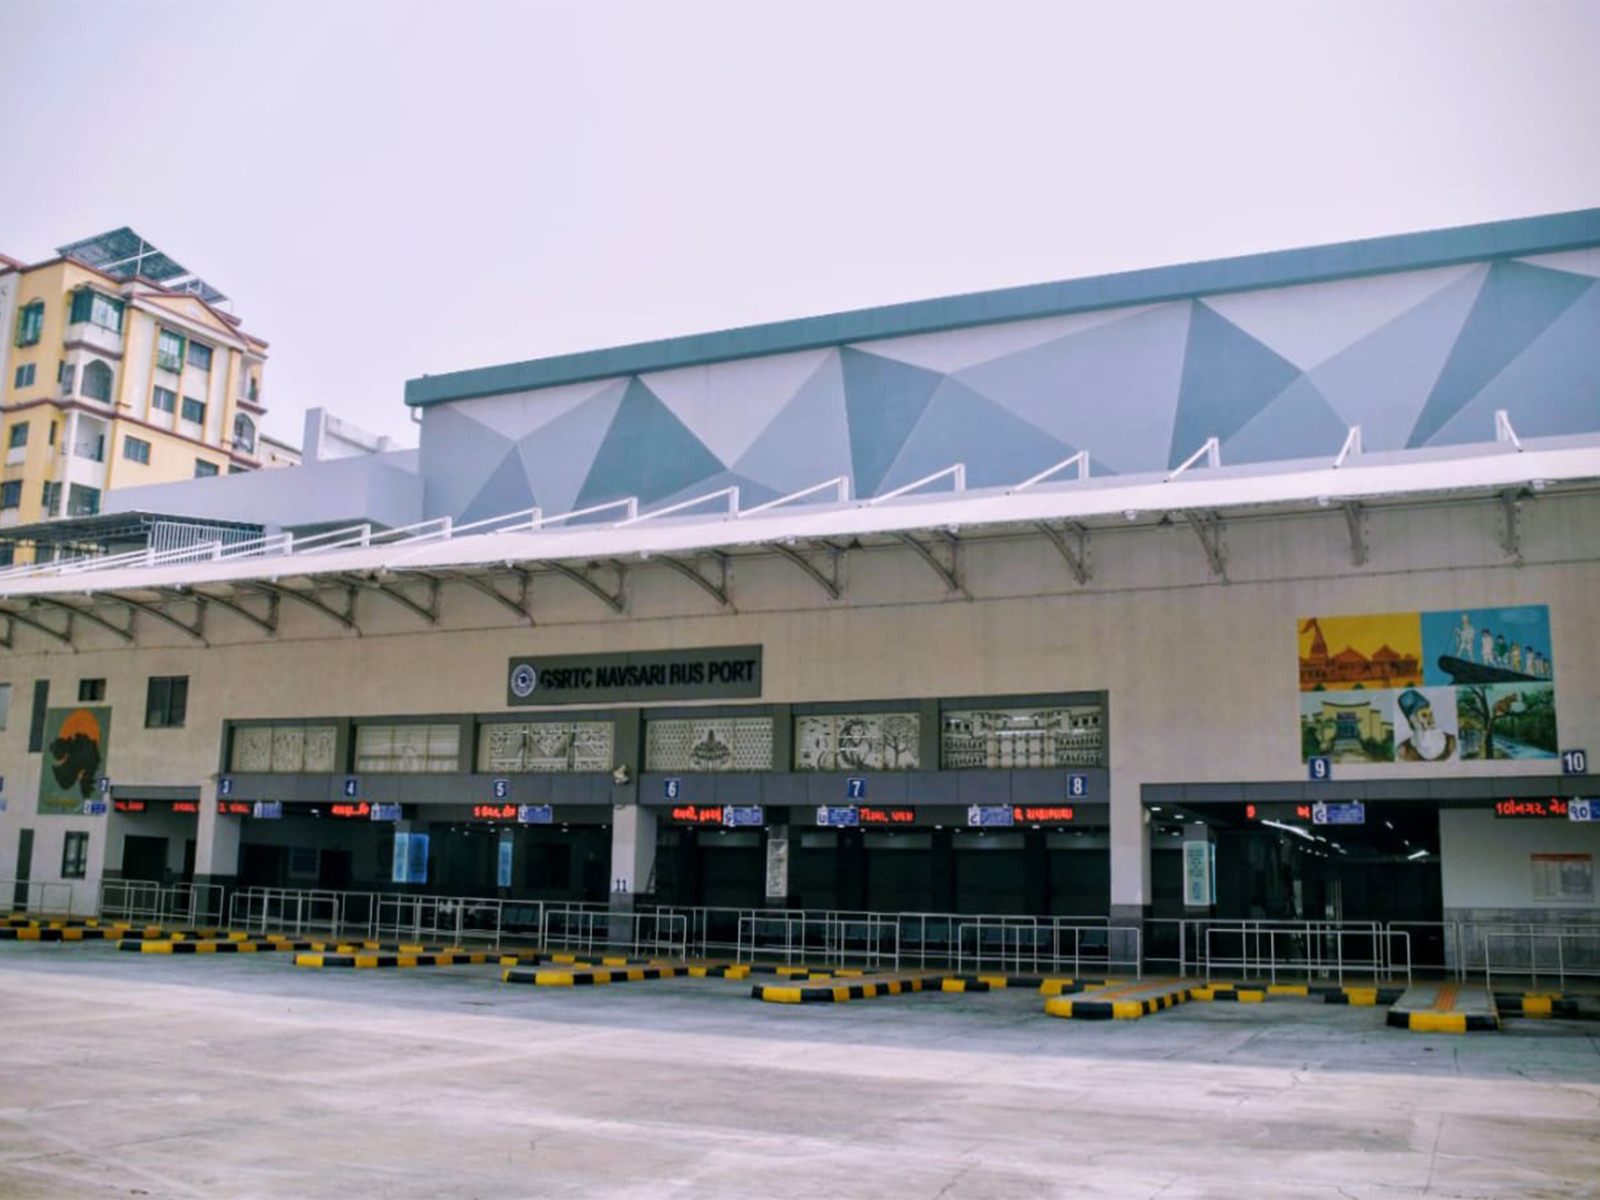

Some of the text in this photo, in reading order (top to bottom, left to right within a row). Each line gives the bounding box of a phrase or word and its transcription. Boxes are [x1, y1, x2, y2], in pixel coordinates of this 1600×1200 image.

[539, 668, 592, 690] GSRTC
[596, 663, 667, 688] NAVSARI
[707, 660, 756, 683] PORT
[1315, 759, 1325, 778] 9
[1564, 752, 1585, 772] 10
[347, 781, 355, 795] 4
[496, 782, 504, 796] 5
[668, 781, 677, 797] 6
[852, 781, 861, 797] 7
[1073, 777, 1083, 795] 8
[615, 879, 628, 893] 11
